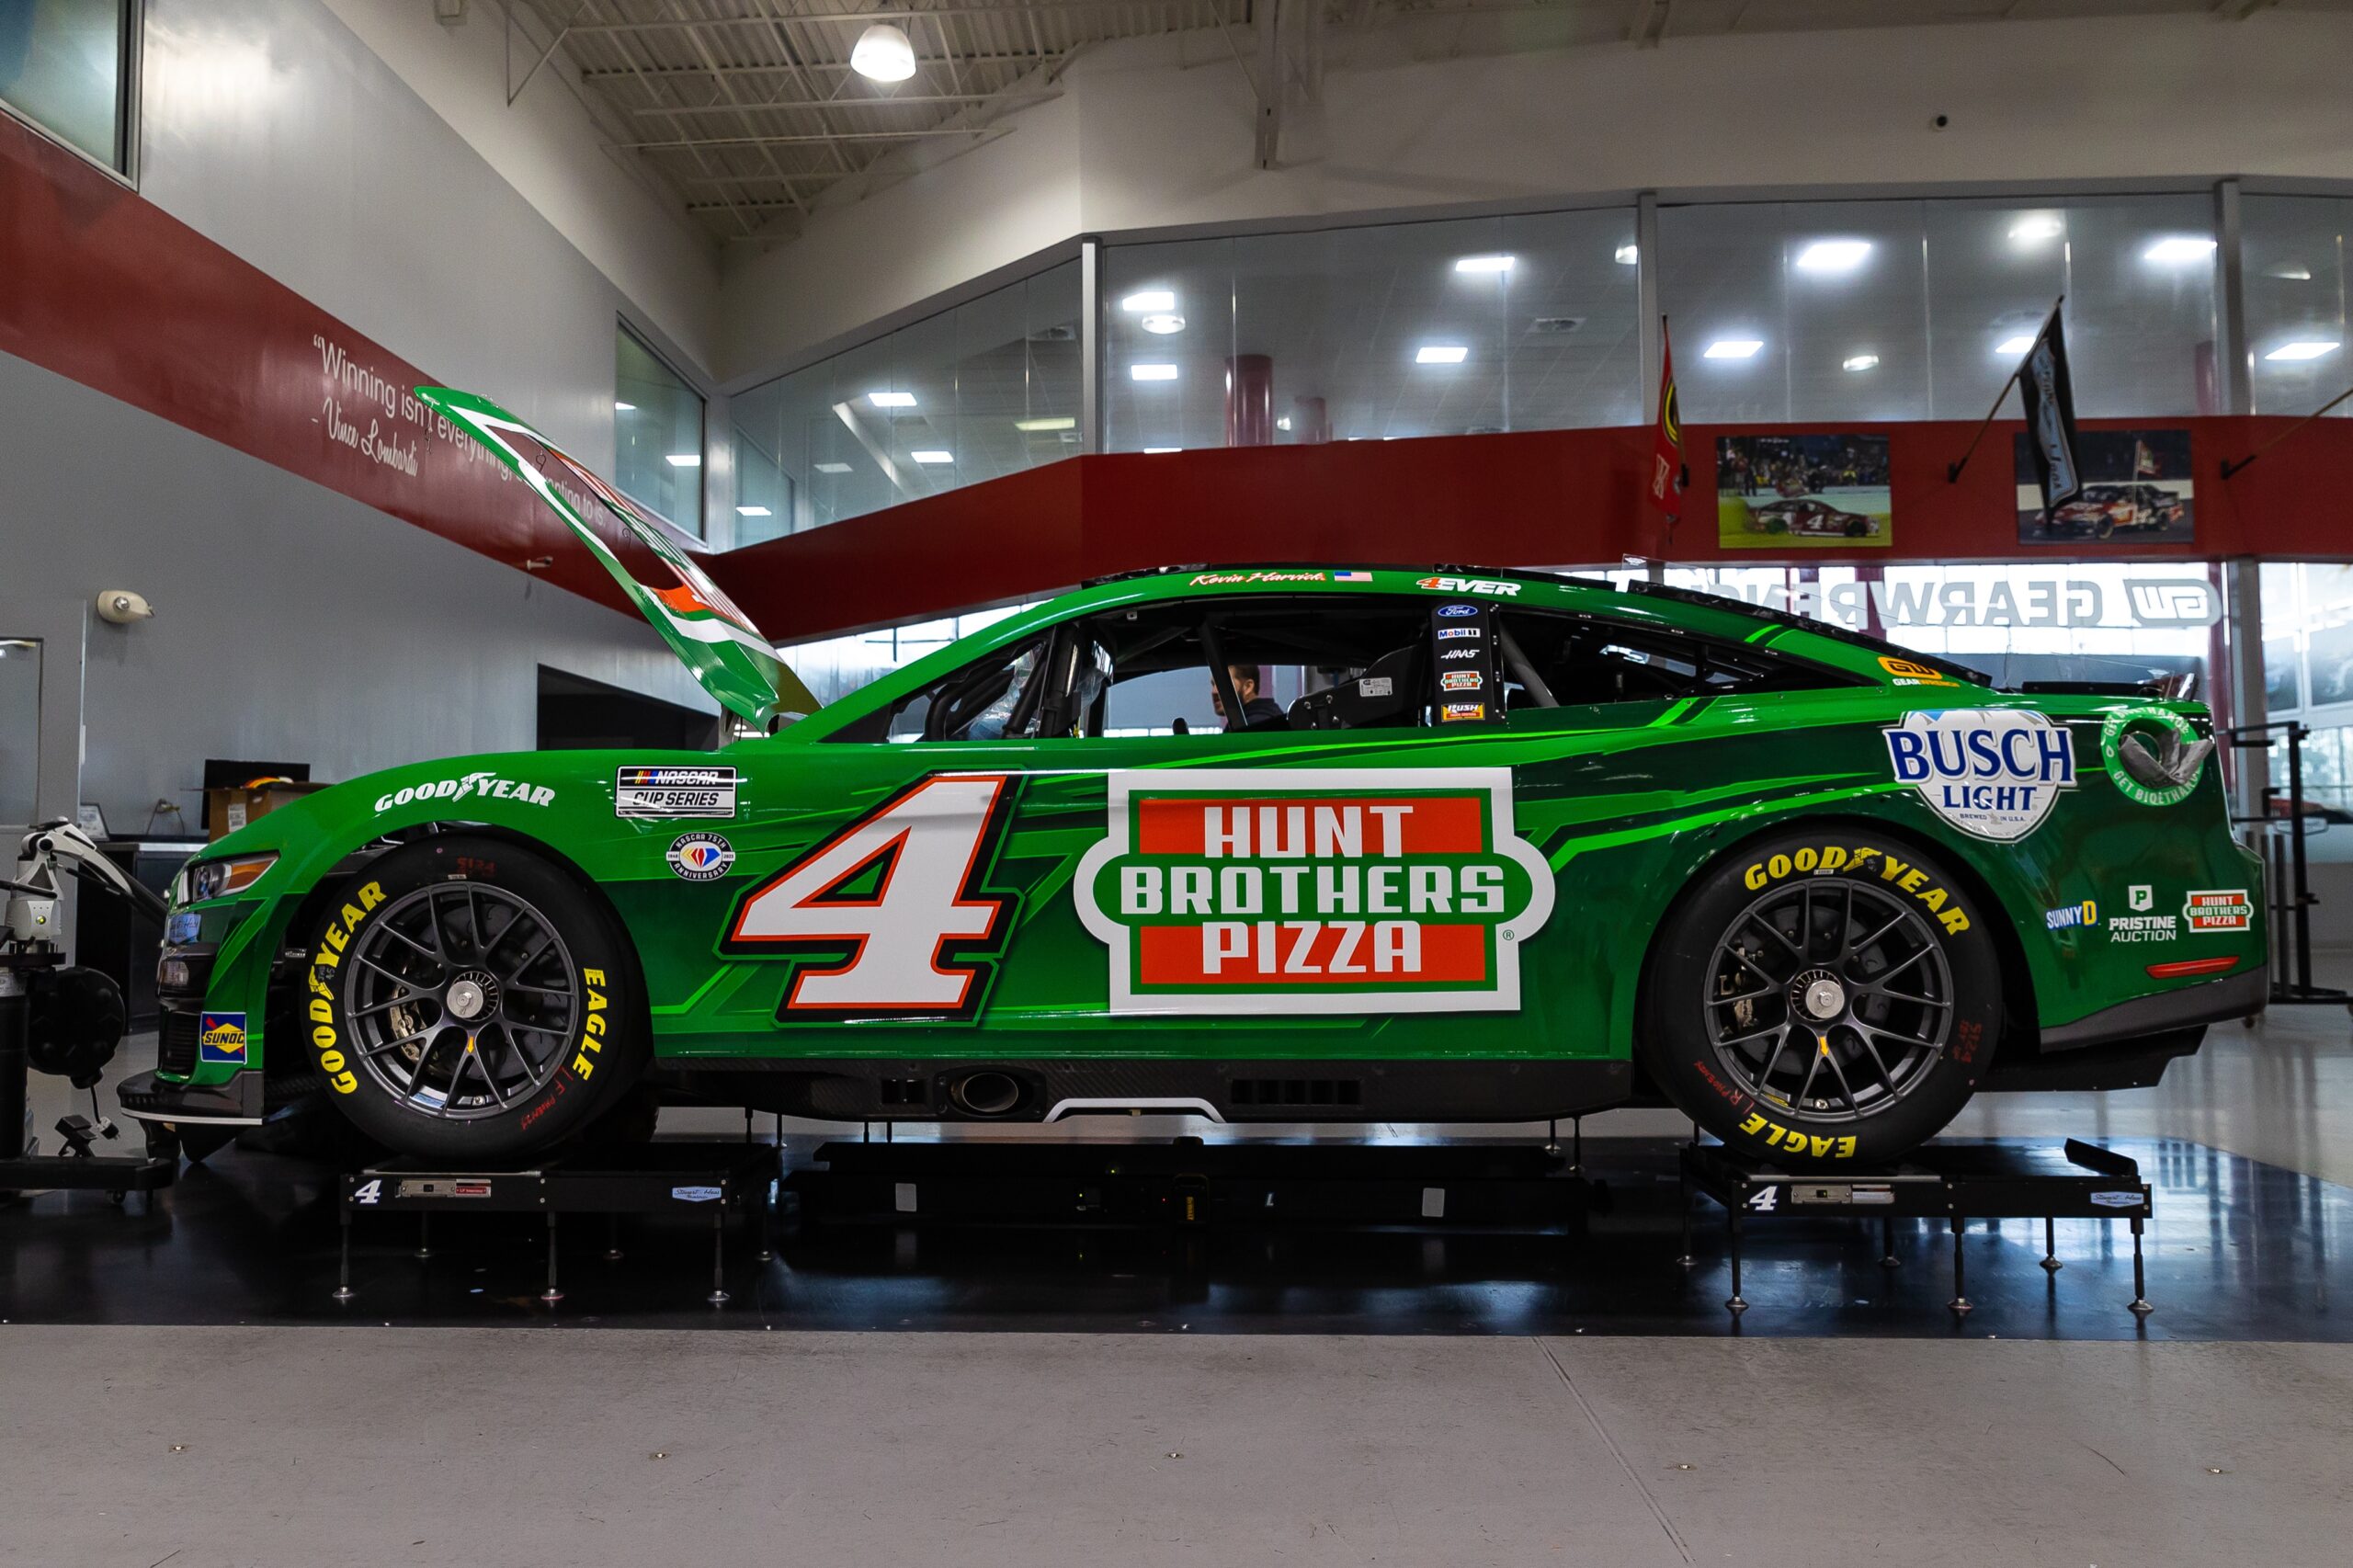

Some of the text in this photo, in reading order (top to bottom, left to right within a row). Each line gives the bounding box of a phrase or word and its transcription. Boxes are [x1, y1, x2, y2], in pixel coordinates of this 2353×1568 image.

[323, 396, 359, 449] Vince
[361, 418, 418, 477] Lombardi
[583, 494, 594, 519] to
[1188, 572, 1326, 586] Kevin Harvick
[1416, 576, 1521, 597] 4EVER
[1445, 606, 1471, 616] Ford
[1439, 629, 1466, 638] Mobil
[1440, 650, 1480, 660] HAAS
[1885, 729, 2073, 783] BUSCH
[655, 770, 719, 785] NASCAR
[2114, 771, 2134, 792] GET
[632, 791, 719, 806] CUP SERIES
[1942, 785, 2037, 811] LIGHT
[1205, 806, 1413, 858] HUNT
[676, 834, 727, 849] NASCAR 75TH
[674, 862, 728, 880] ANNIVERSARY
[731, 776, 1007, 1009] 4
[1120, 866, 1505, 915] BROTHERS
[2135, 890, 2147, 905] P
[2202, 896, 2234, 906] HUNT
[2189, 905, 2248, 916] BROTHERS
[2109, 916, 2177, 931] PRISTINE
[2202, 915, 2236, 926] PIZZA
[2110, 930, 2177, 942] AUCTION
[1202, 920, 1421, 974] PIZZA
[573, 967, 608, 1081] EAGLE
[204, 1032, 245, 1044] SUNOC
[1739, 1112, 1857, 1158] EAGLE
[355, 1179, 382, 1204] 4
[1749, 1186, 1778, 1210] 4
